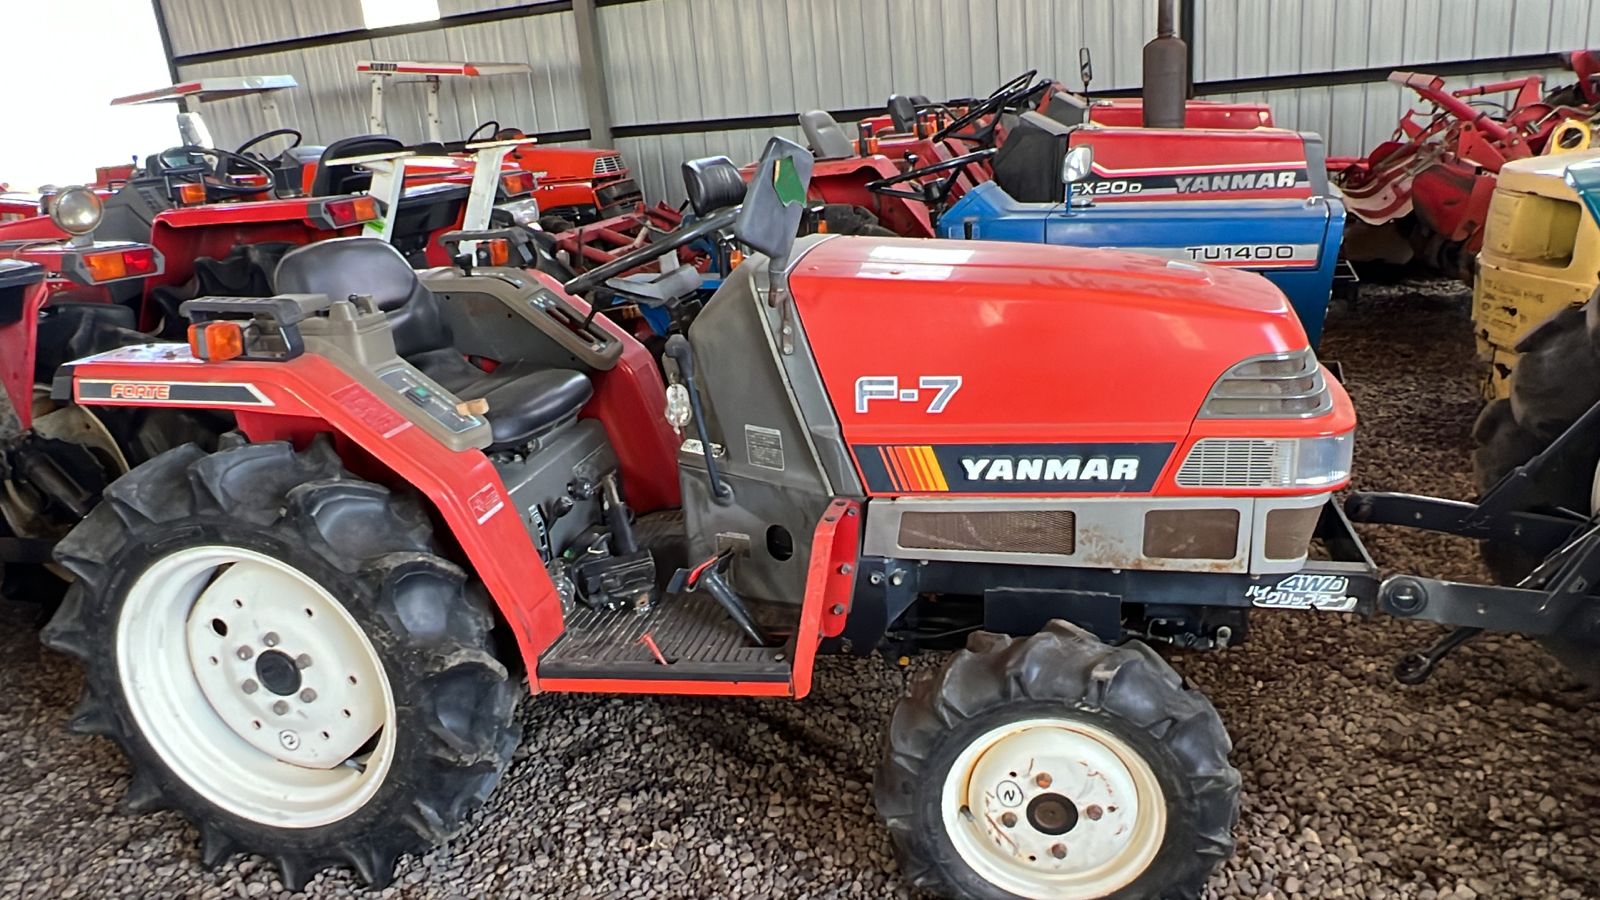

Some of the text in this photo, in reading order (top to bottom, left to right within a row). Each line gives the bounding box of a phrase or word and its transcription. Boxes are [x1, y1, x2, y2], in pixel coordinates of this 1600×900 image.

[1175, 171, 1297, 193] YANMAR
[1187, 245, 1293, 260] TU1400
[111, 383, 170, 400] FORTE
[855, 375, 963, 414] F-7
[960, 456, 1140, 482] YANMAR
[1276, 574, 1349, 594] 4WD
